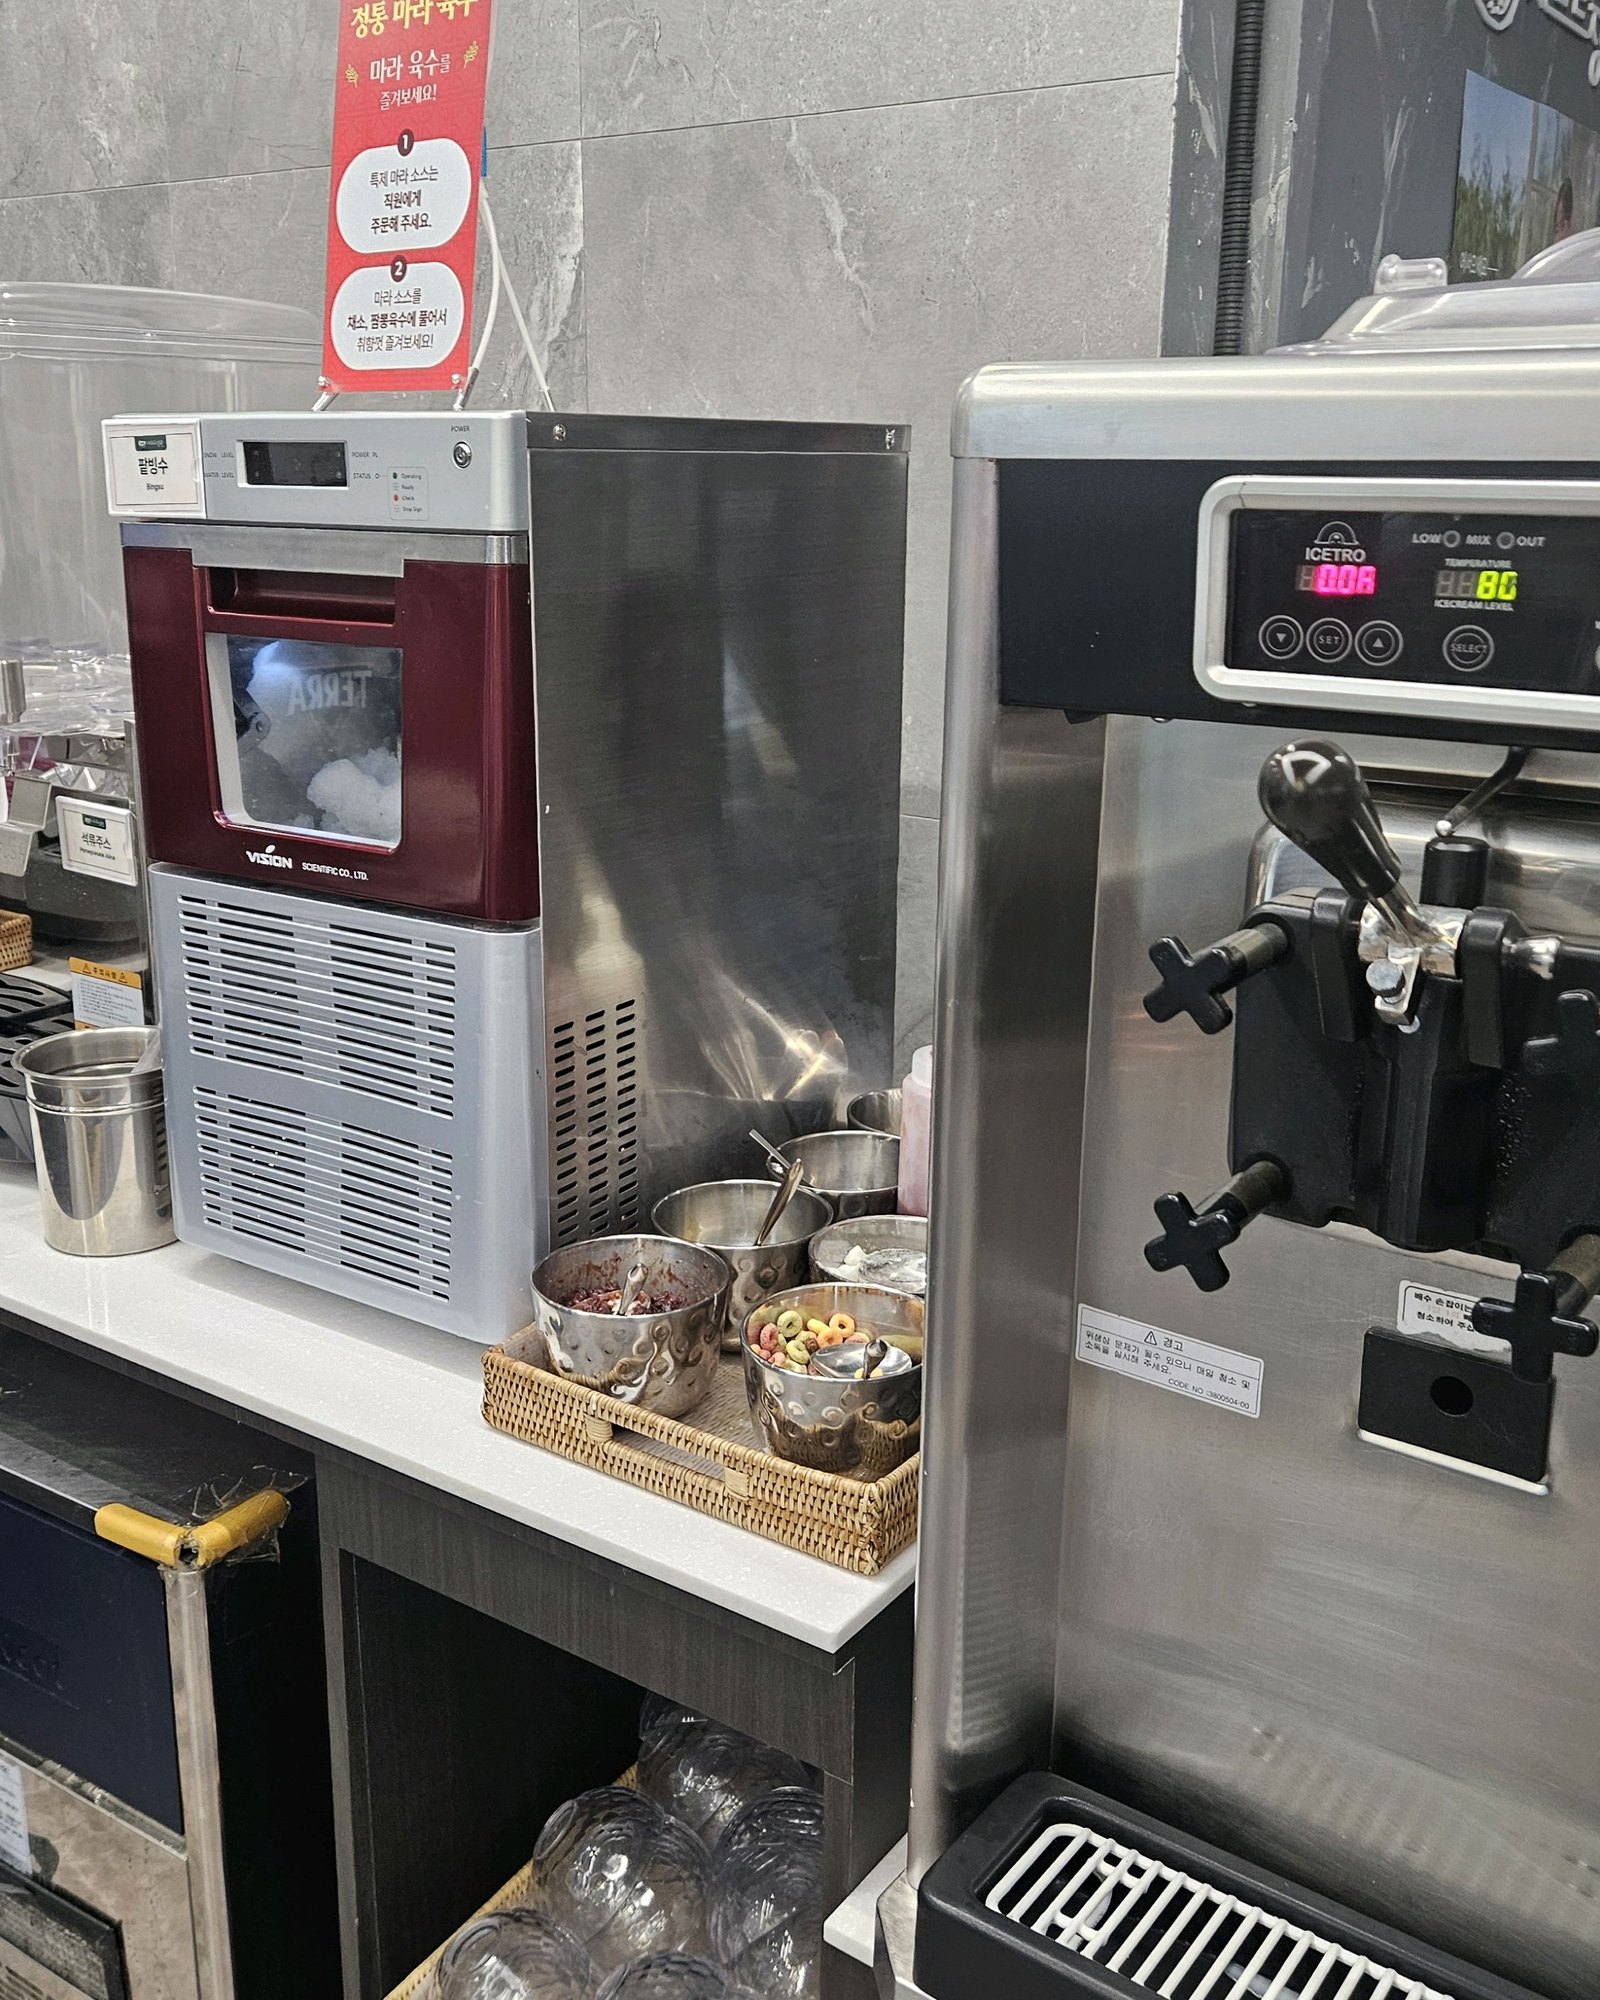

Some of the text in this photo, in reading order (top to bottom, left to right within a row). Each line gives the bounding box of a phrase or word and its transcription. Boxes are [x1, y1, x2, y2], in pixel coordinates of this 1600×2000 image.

[350, 2, 389, 38] 정통
[392, 0, 434, 29] 마라
[370, 49, 451, 83] 마라 육수를
[380, 84, 437, 111] 즐겨보세요!
[402, 134, 408, 149] 1
[370, 165, 439, 188] 특제 마라 소스는
[384, 189, 421, 209] 직원에게
[371, 213, 432, 234] 주문해 주세요.
[394, 261, 402, 276] 2
[374, 288, 421, 307] 마라 소스를
[370, 311, 416, 329] 짬뽕육수에
[418, 308, 447, 327] 풀어서
[357, 334, 433, 352] 취향껏 즐겨보세요!
[138, 457, 168, 475] 팥빙수
[1412, 533, 1546, 547] LOW MIX OUT
[1305, 547, 1366, 563] ICETRO
[1444, 558, 1511, 568] TEMPERATURE
[1434, 599, 1514, 611] ICECREAM LEVEL
[1318, 634, 1339, 645] SET
[1450, 643, 1487, 654] SELECT
[82, 832, 112, 850] 석류주스
[246, 846, 293, 869] VISION
[302, 862, 338, 876] SCIENTIFIC
[1414, 1292, 1432, 1303] 배수
[1436, 1298, 1473, 1313] 손잡이는
[1417, 1311, 1453, 1327] 청소하여
[1163, 1337, 1183, 1351] 경고
[1085, 1330, 1110, 1345] 위생상
[1115, 1340, 1140, 1354] 문제가
[1166, 1356, 1192, 1371] 있으니
[1196, 1366, 1214, 1378] 매일
[1219, 1373, 1236, 1385] 청소
[1085, 1340, 1171, 1375] 소독을 실시해 주세요.
[1168, 1378, 1190, 1390] CODE
